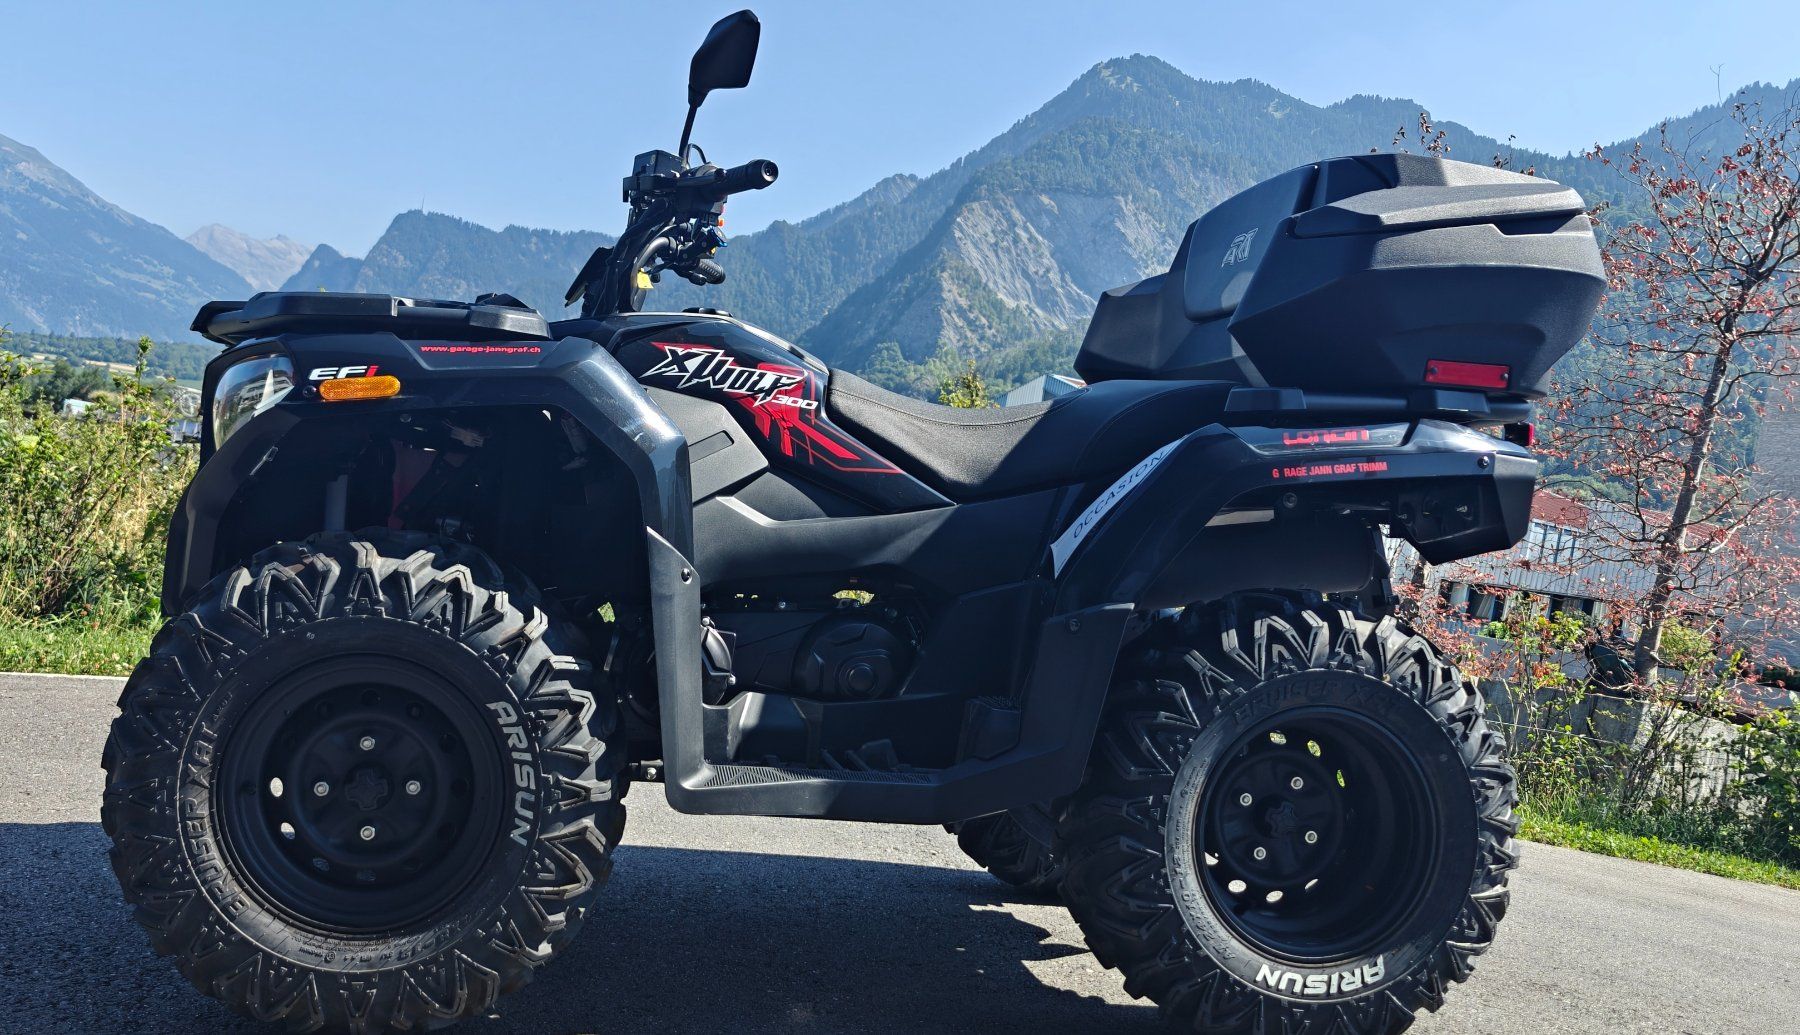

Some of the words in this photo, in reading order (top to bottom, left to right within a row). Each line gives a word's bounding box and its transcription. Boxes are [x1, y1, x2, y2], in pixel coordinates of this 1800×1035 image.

[420, 345, 541, 354] www.garage-janngraf.ch
[771, 394, 819, 410] 300
[1309, 464, 1333, 476] JANN
[1333, 463, 1357, 474] GRAF
[1357, 461, 1388, 472] TRIMM
[1073, 451, 1164, 539] OCCASION
[485, 701, 537, 847] ARISUN
[185, 797, 251, 918] BRUISER
[1256, 955, 1386, 995] ARISUN
